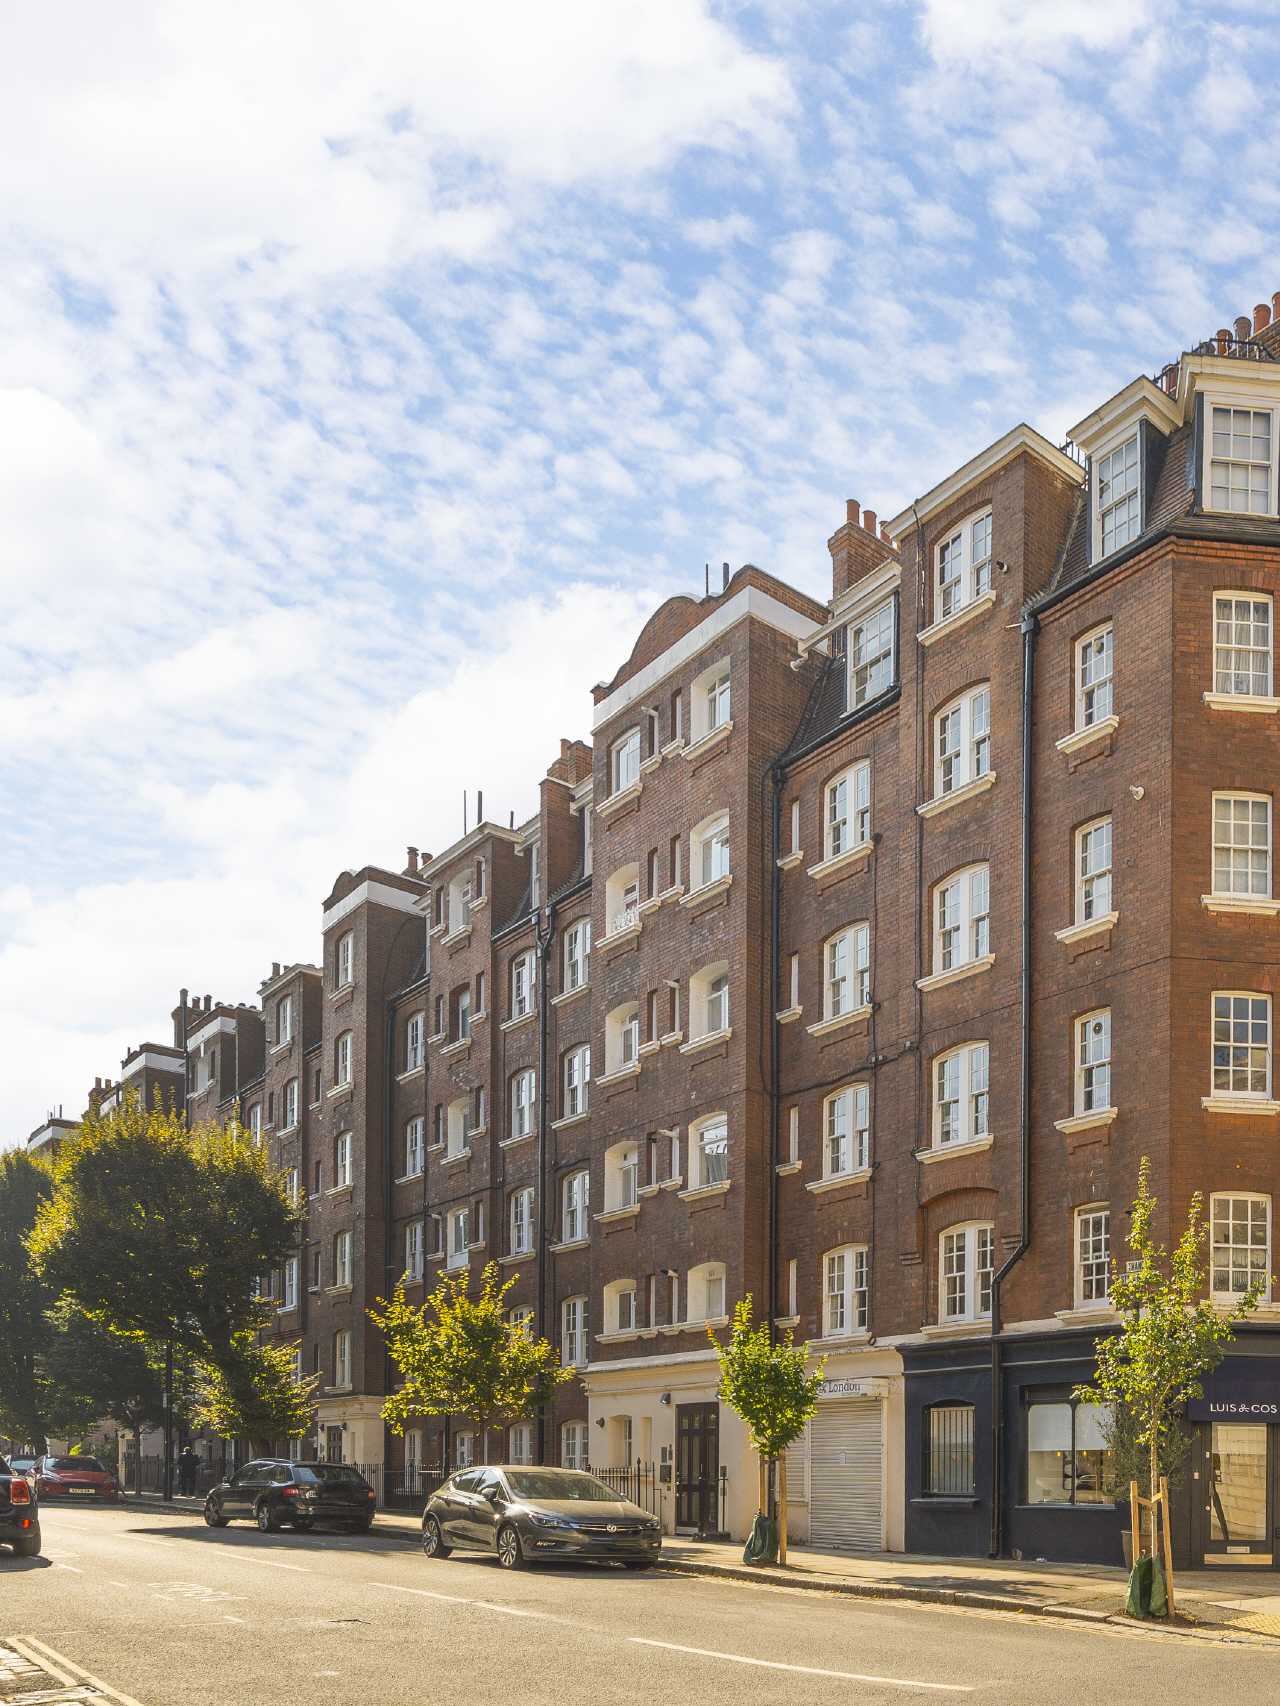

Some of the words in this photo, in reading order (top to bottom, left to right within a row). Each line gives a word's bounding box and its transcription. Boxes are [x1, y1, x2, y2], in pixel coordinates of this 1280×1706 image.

[828, 1381, 861, 1393] London
[1210, 1403, 1237, 1412] LUIS
[1238, 1403, 1250, 1413] &
[1251, 1404, 1278, 1414] COS
